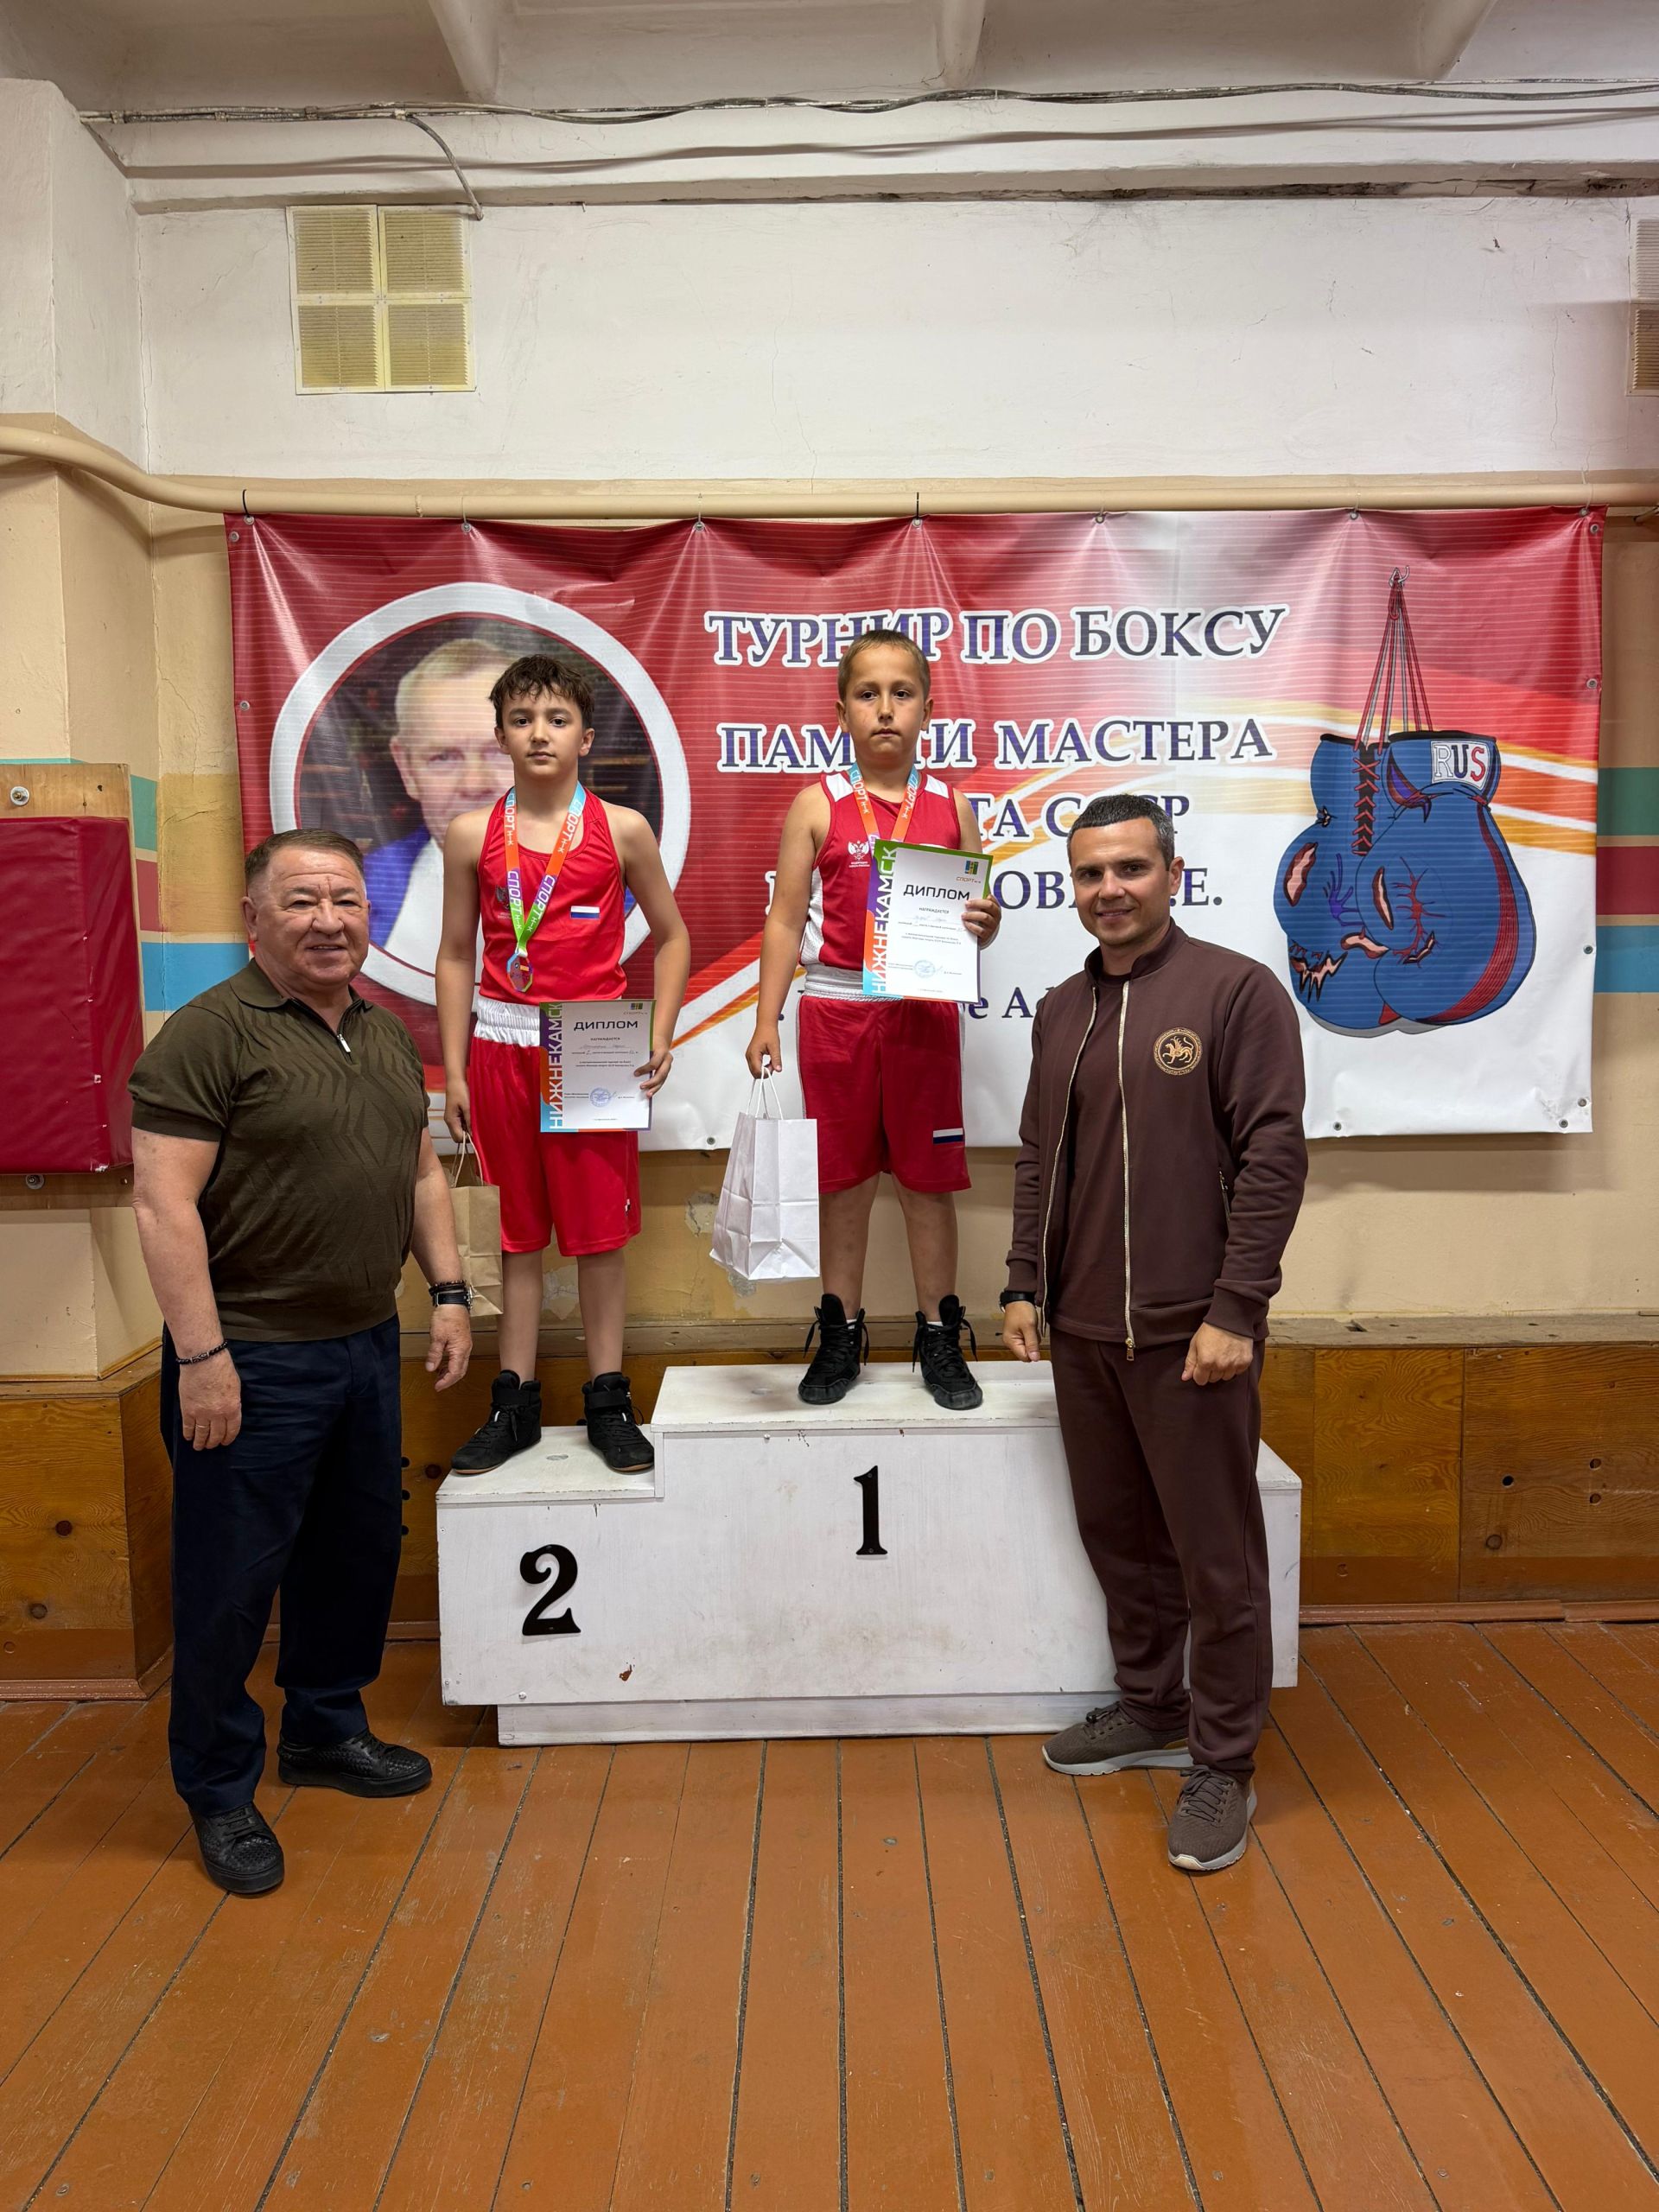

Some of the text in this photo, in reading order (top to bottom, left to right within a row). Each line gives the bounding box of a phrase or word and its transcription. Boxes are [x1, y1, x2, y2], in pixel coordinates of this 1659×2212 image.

[963, 612, 1058, 660] ПО
[1074, 607, 1287, 658] БОКСУ
[721, 718, 1274, 768] ПАМИ МАСТЕРА
[1433, 744, 1486, 782] RUS
[850, 769, 868, 804] СПОРТ
[506, 871, 523, 915] СПОРТ
[532, 874, 556, 920] СПОРТ
[902, 883, 970, 901] ДИПЛОМ
[871, 846, 898, 994] НИЖНЕКАМСК
[573, 1020, 639, 1032] ДИПЛОМ
[548, 1002, 563, 1130] НИЖНЕКАМСК
[853, 1465, 888, 1555] 1
[519, 1543, 582, 1637] 2
